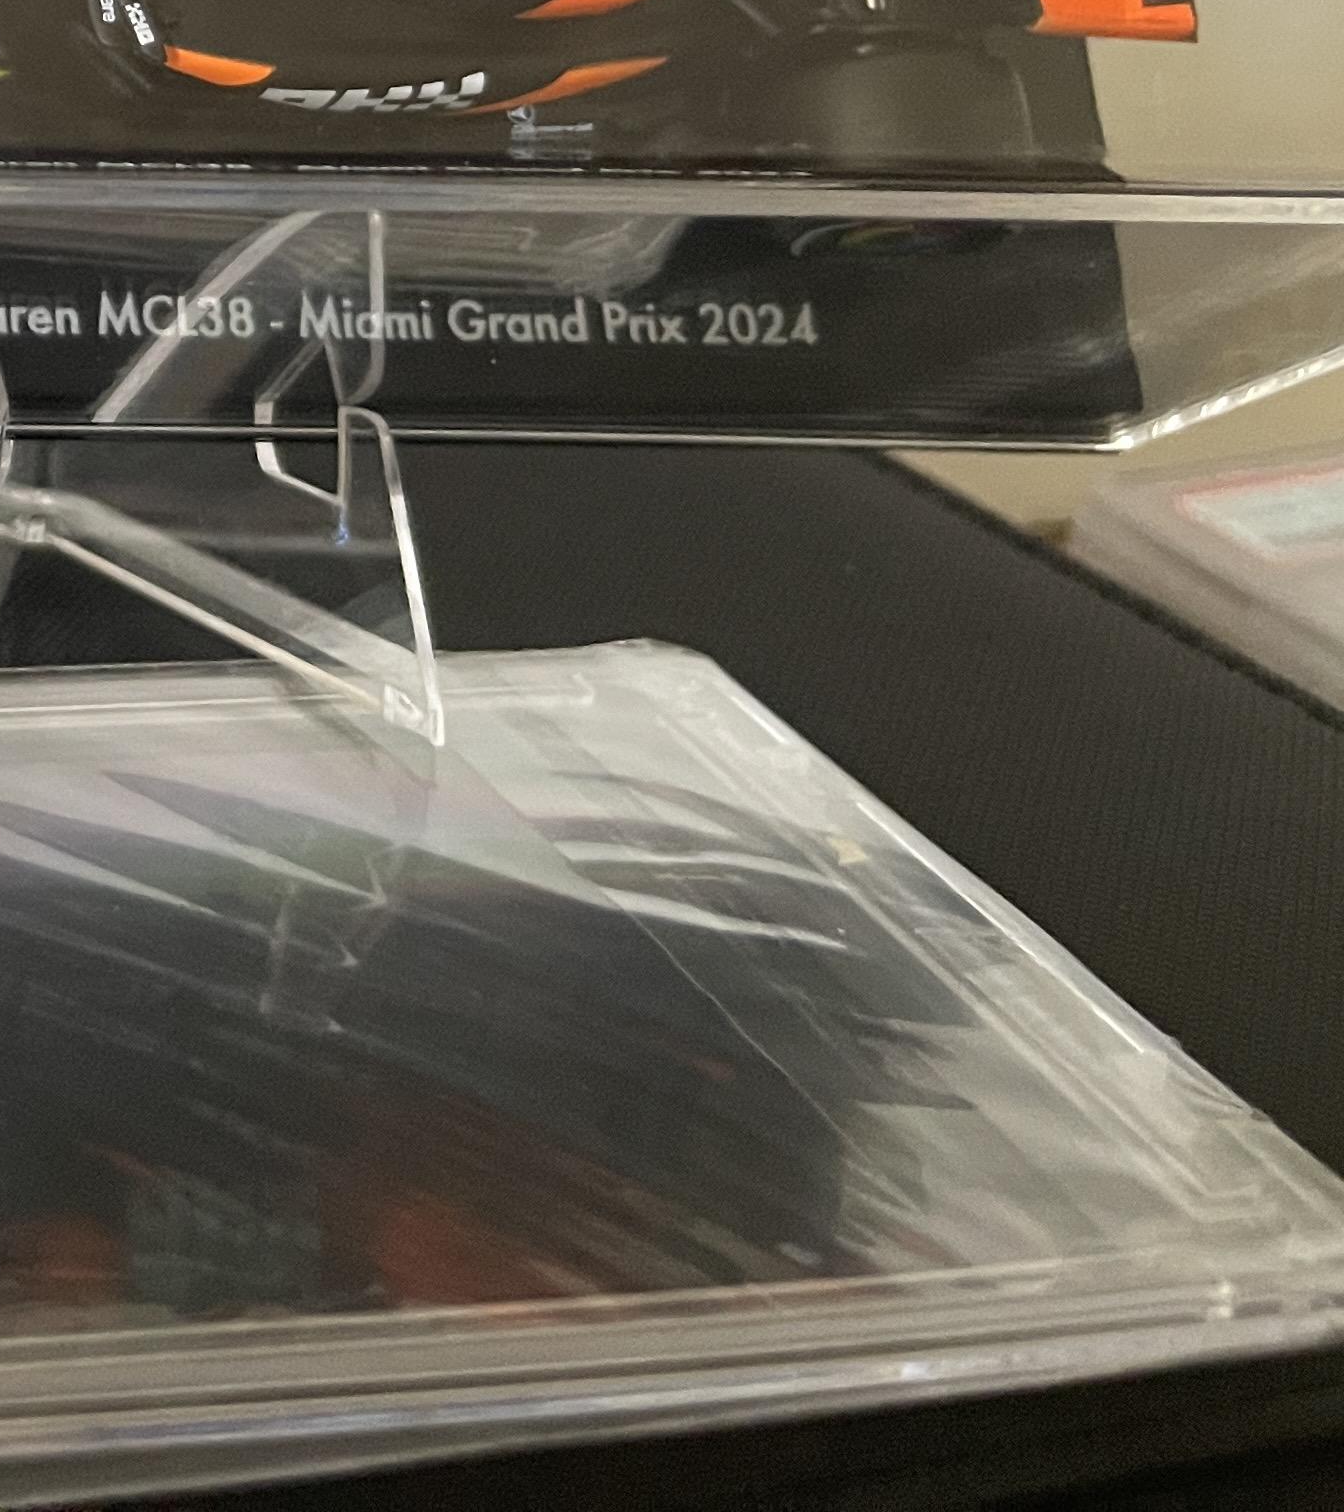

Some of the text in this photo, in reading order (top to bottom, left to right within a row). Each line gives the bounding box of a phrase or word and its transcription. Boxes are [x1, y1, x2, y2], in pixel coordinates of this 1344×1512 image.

[97, 291, 255, 339] MCL38
[299, 291, 434, 342] Miami
[447, 296, 588, 344] Grand
[602, 300, 688, 345] Prix
[698, 302, 819, 348] 2024
